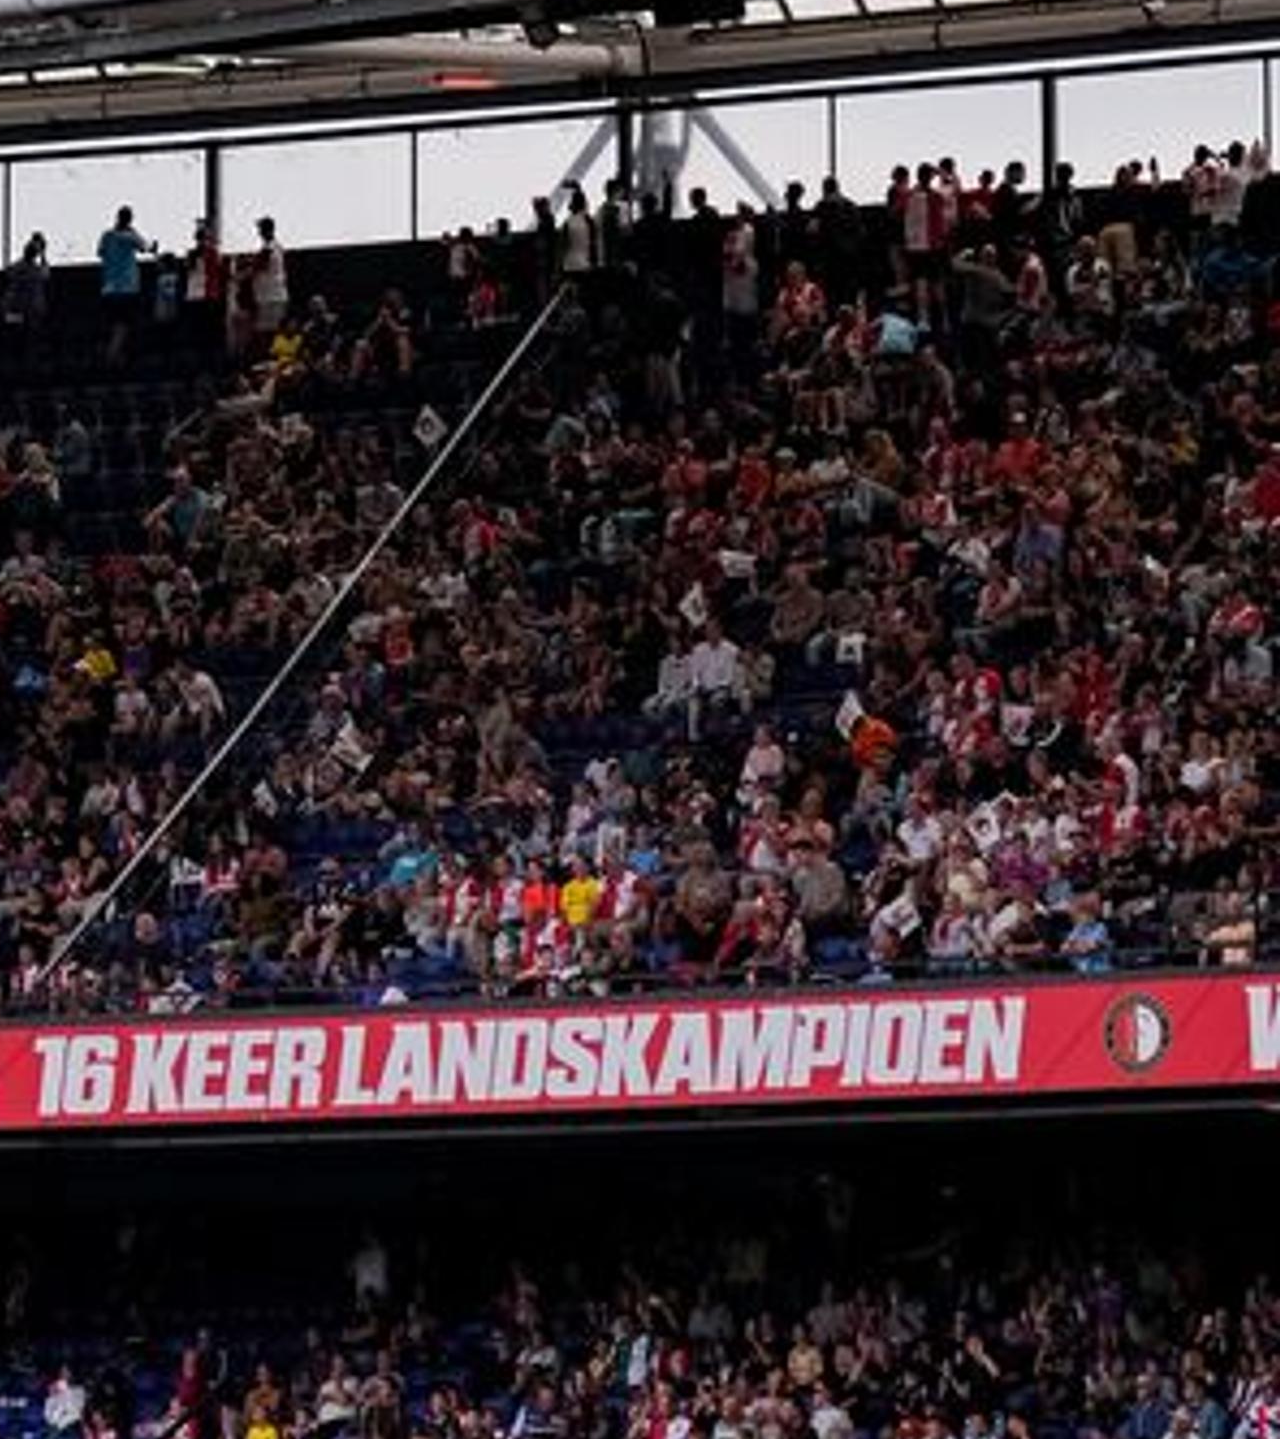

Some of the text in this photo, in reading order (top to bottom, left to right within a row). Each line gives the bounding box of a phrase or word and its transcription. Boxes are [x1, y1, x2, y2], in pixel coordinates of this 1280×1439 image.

[36, 997, 1026, 1116] 16 KEER LANDSKAMPIOEN
